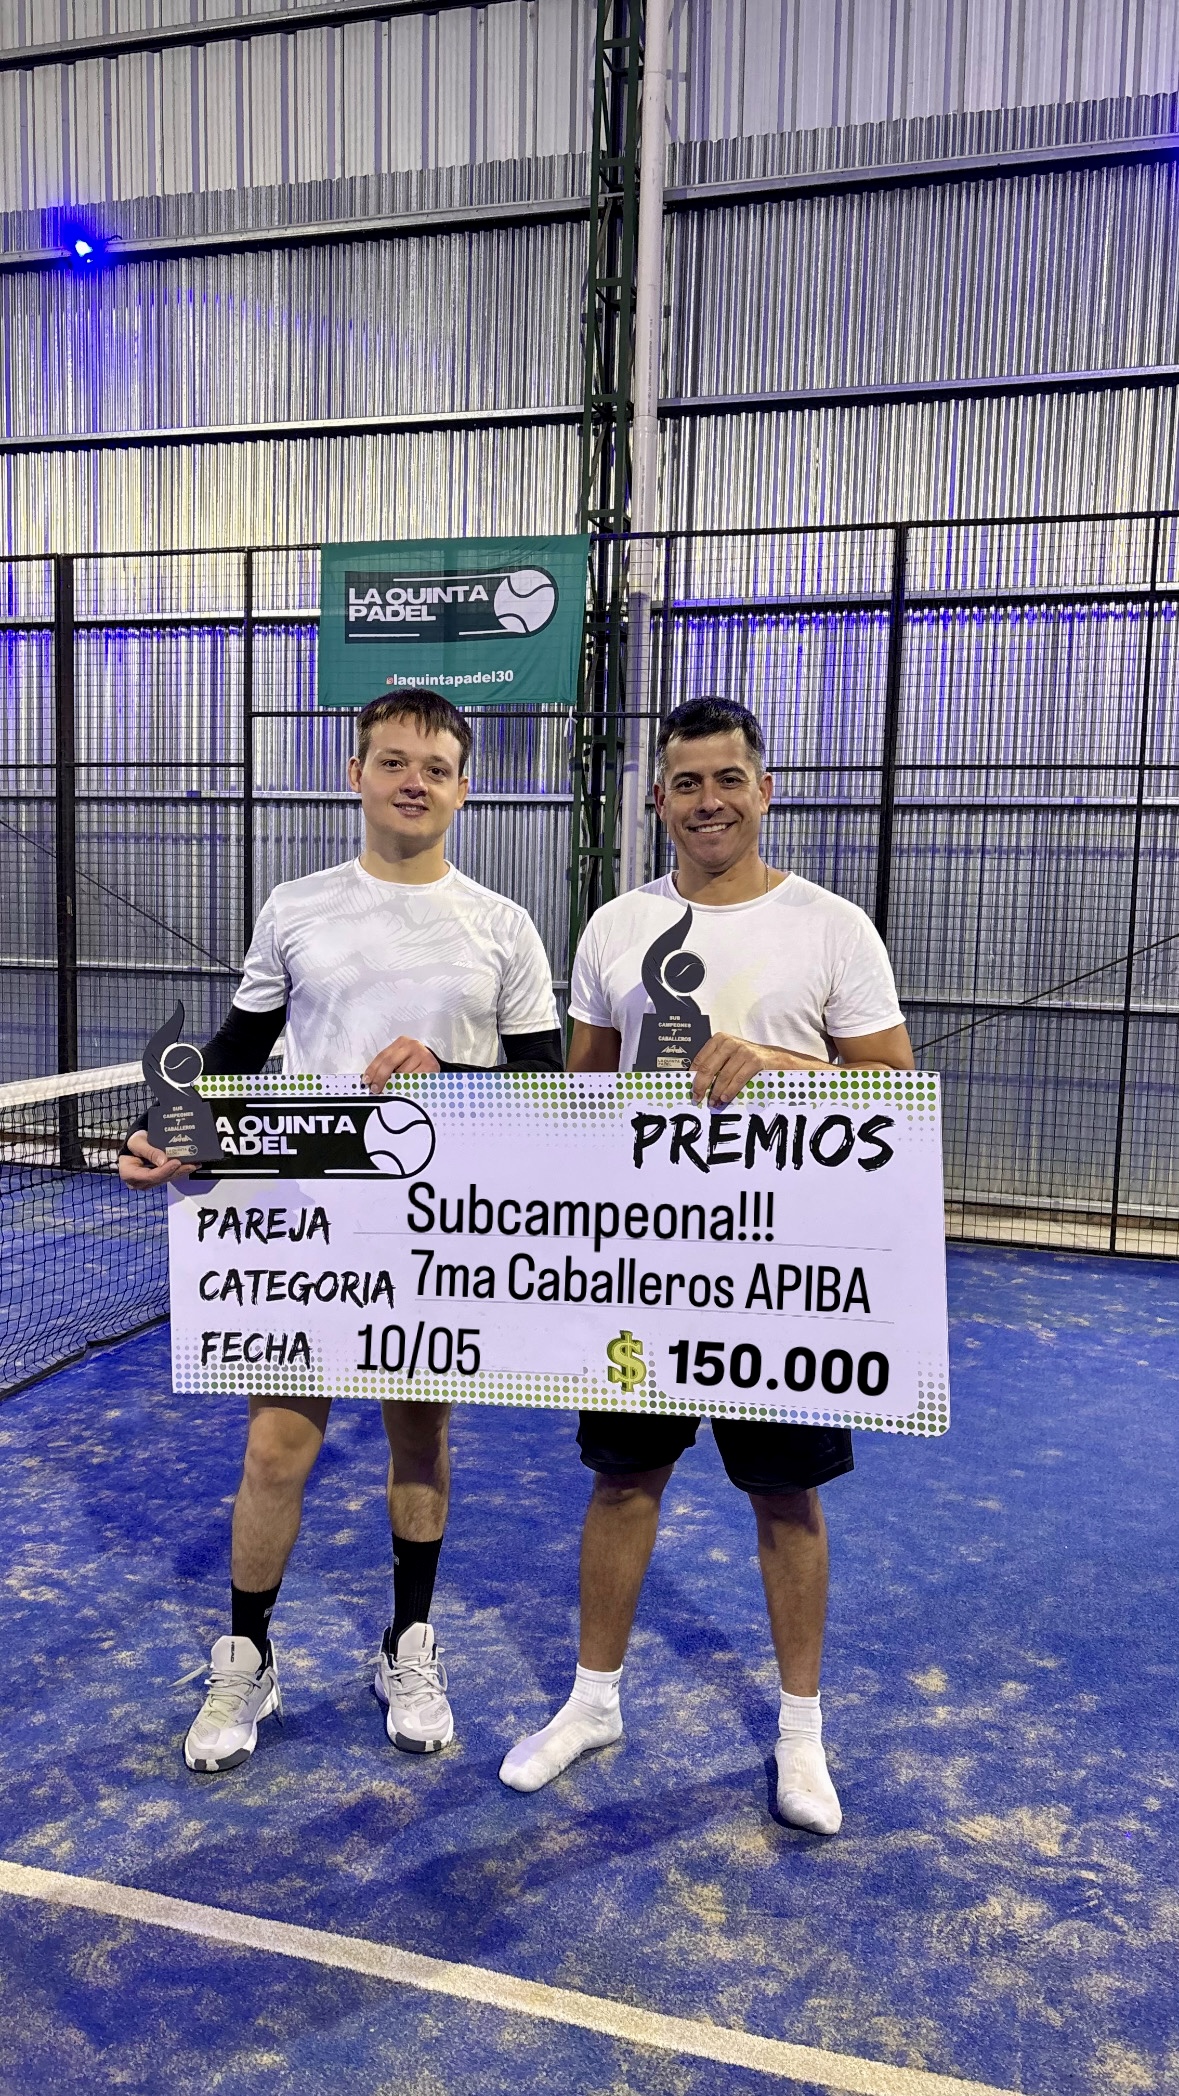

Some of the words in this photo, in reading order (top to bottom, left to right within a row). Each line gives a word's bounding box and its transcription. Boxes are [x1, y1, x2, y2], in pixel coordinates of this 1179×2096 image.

[349, 587, 383, 604] LA
[385, 585, 489, 605] QUINTA
[349, 604, 436, 622] PADEL
[393, 669, 514, 687] laquintapadel30
[215, 1116, 235, 1135] A
[238, 1115, 357, 1136] QUINTA
[220, 1136, 298, 1155] ADEL
[631, 1110, 895, 1173] PREMIOS
[197, 1206, 332, 1245] PAREJA
[407, 1181, 775, 1254] Subcampeona!!!
[199, 1268, 396, 1309] CATEGORIA
[411, 1249, 495, 1298] 7ma
[508, 1252, 735, 1309] Caballeros
[745, 1263, 871, 1314] APIBA
[201, 1331, 312, 1369] FECHA
[357, 1321, 481, 1379] 10/05
[668, 1340, 890, 1397] 150.000
